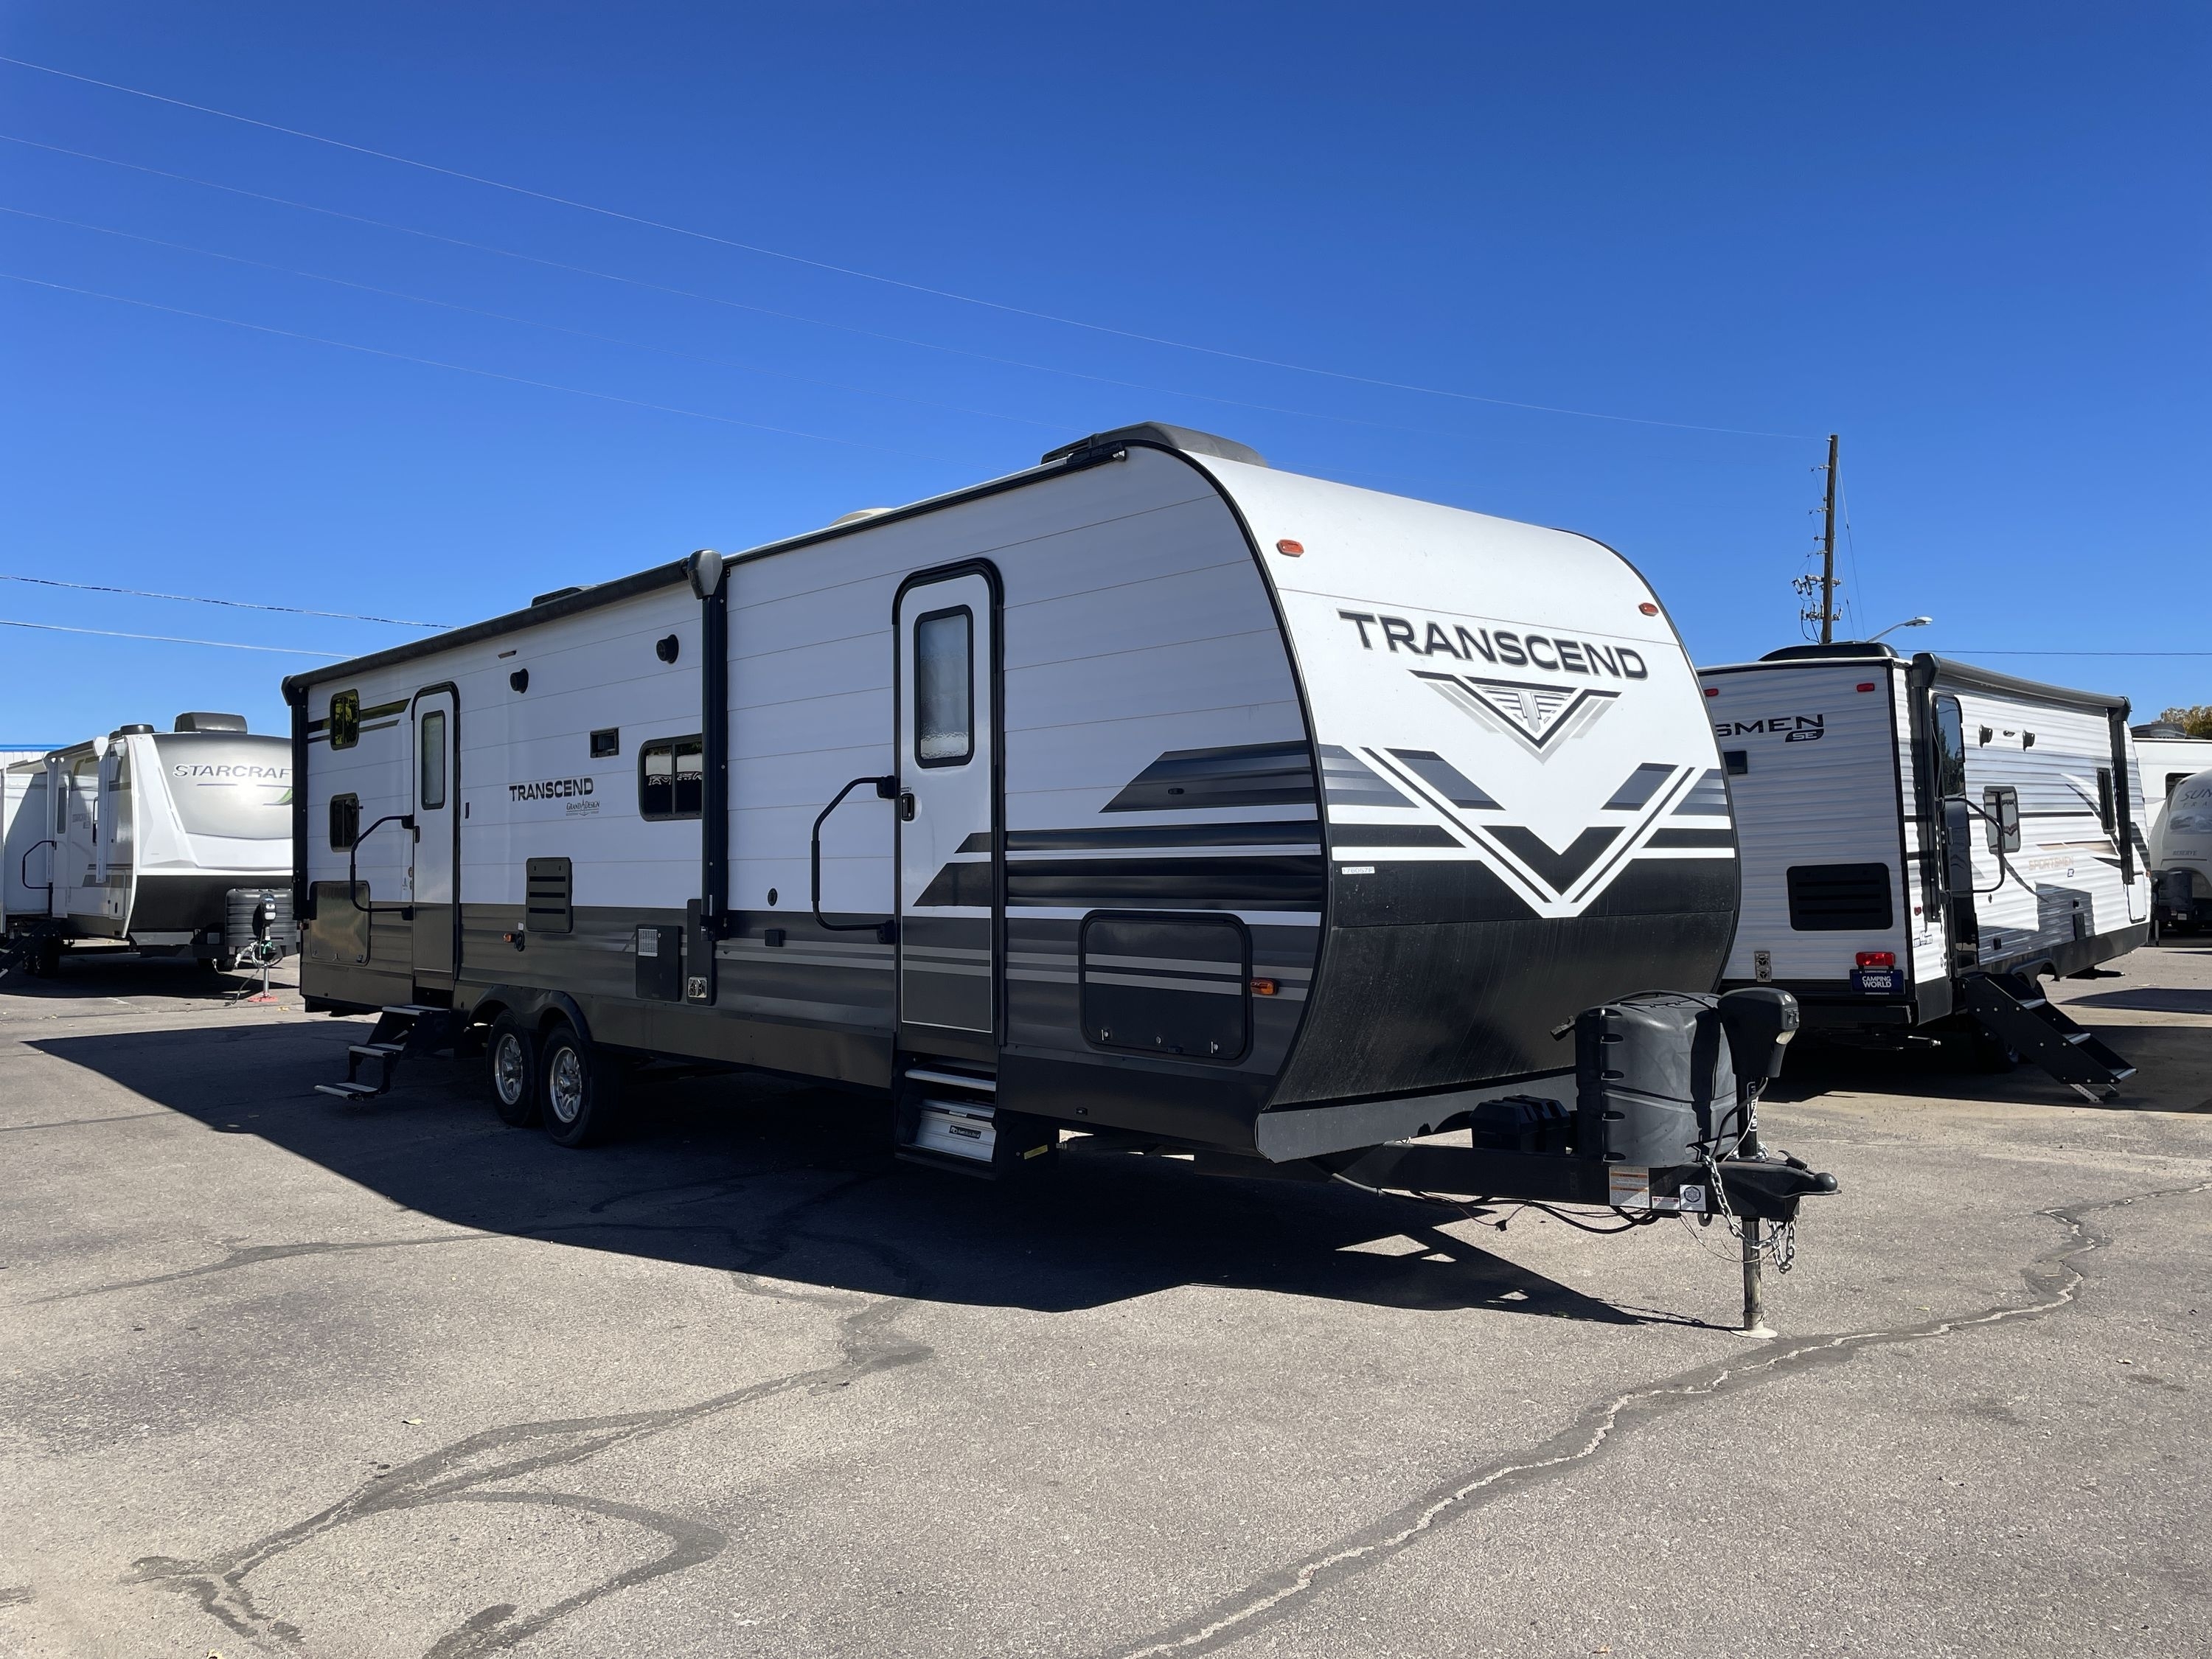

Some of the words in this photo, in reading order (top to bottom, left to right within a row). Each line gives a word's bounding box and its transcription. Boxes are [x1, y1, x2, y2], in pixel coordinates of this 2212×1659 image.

[1337, 608, 1648, 680] TRANSCEND
[1792, 731, 1818, 740] SE
[509, 778, 594, 801] TRANSCEND
[566, 801, 581, 810] GRAND
[585, 801, 599, 809] DESIGN
